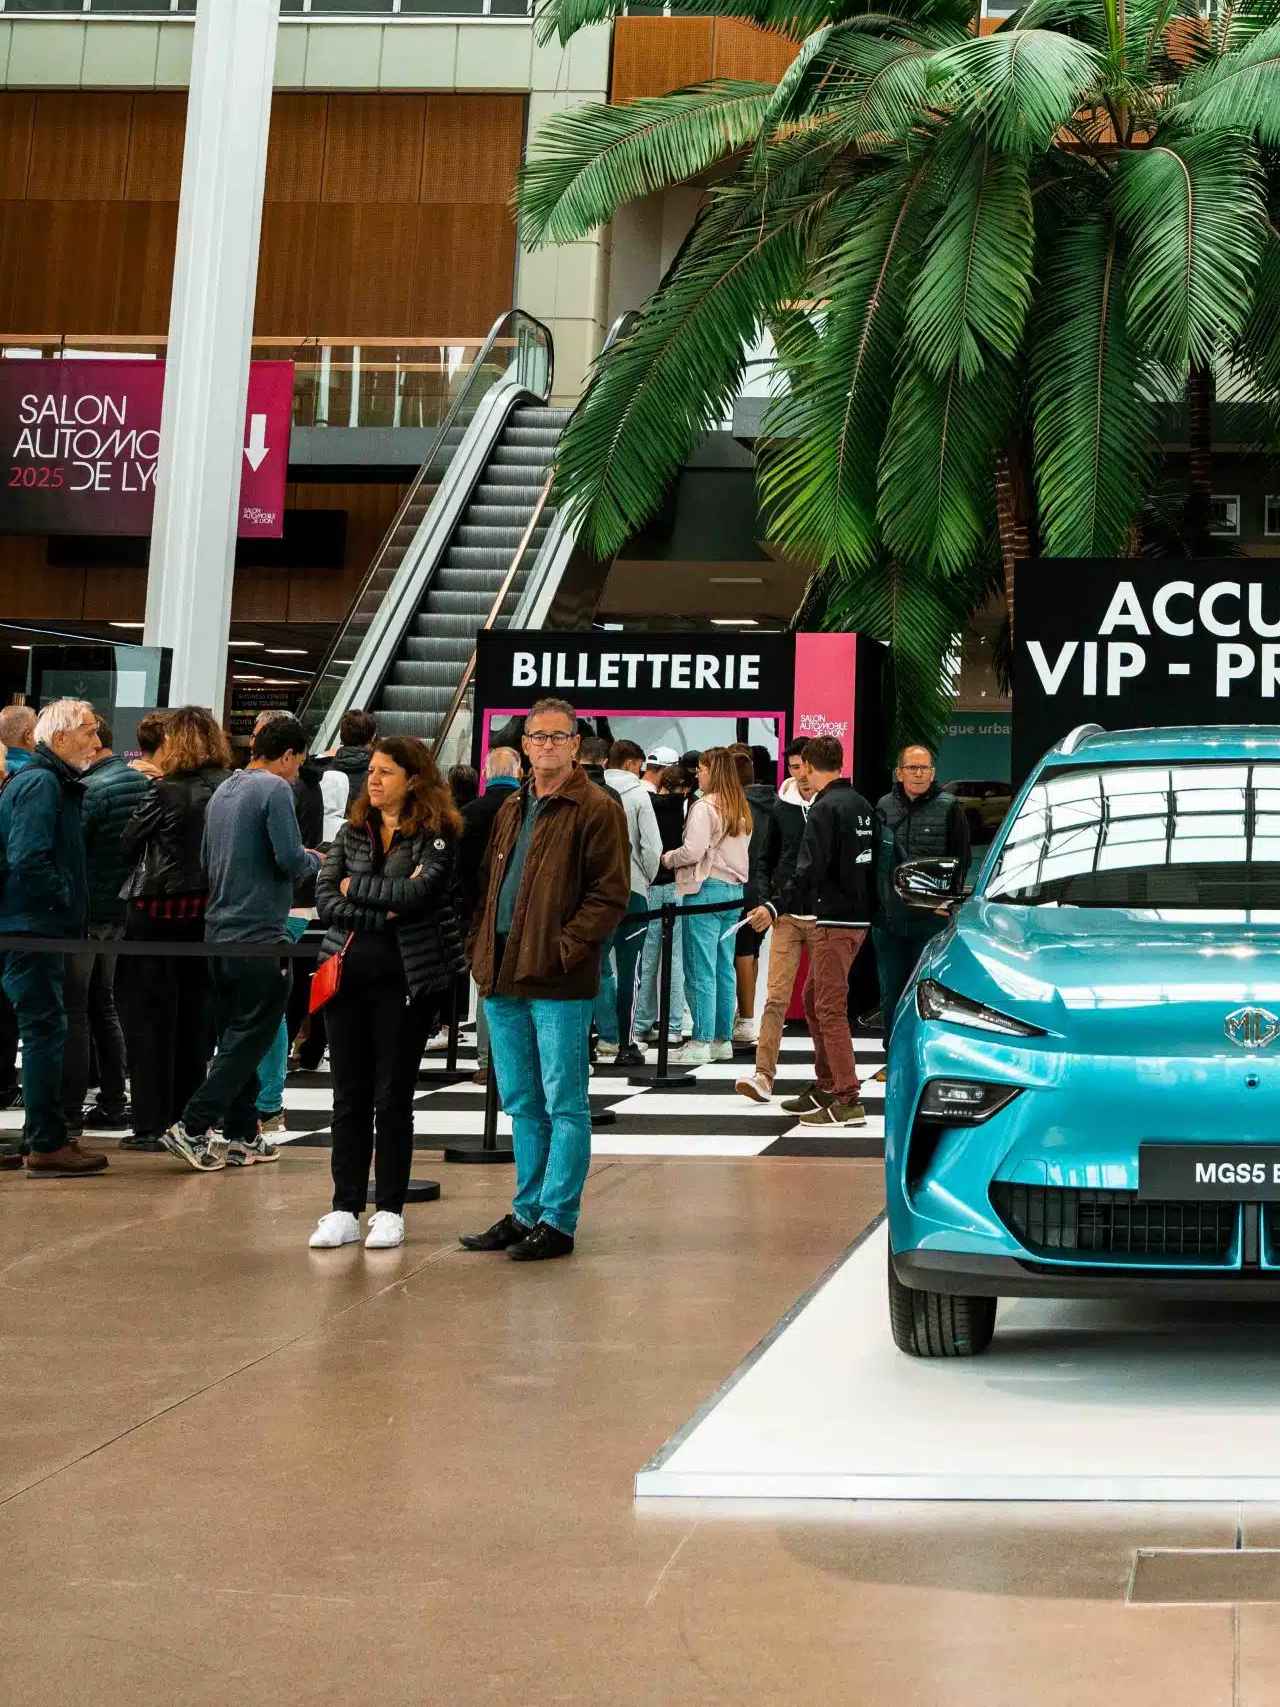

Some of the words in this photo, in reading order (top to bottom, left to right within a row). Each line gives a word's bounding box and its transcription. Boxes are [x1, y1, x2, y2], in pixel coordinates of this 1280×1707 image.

[19, 394, 127, 425] SALON
[13, 428, 161, 459] AUTOMO
[8, 466, 65, 488] 2025
[70, 461, 112, 491] DE
[121, 461, 158, 492] LY
[512, 651, 761, 690] BILLETTERIE
[1026, 640, 1147, 696] VIP
[800, 714, 825, 723] SALON
[800, 722, 848, 731] AUTOMOBILE
[979, 723, 1012, 734] urba
[1228, 1011, 1277, 1044] MG
[1195, 1162, 1266, 1184] MGS5
